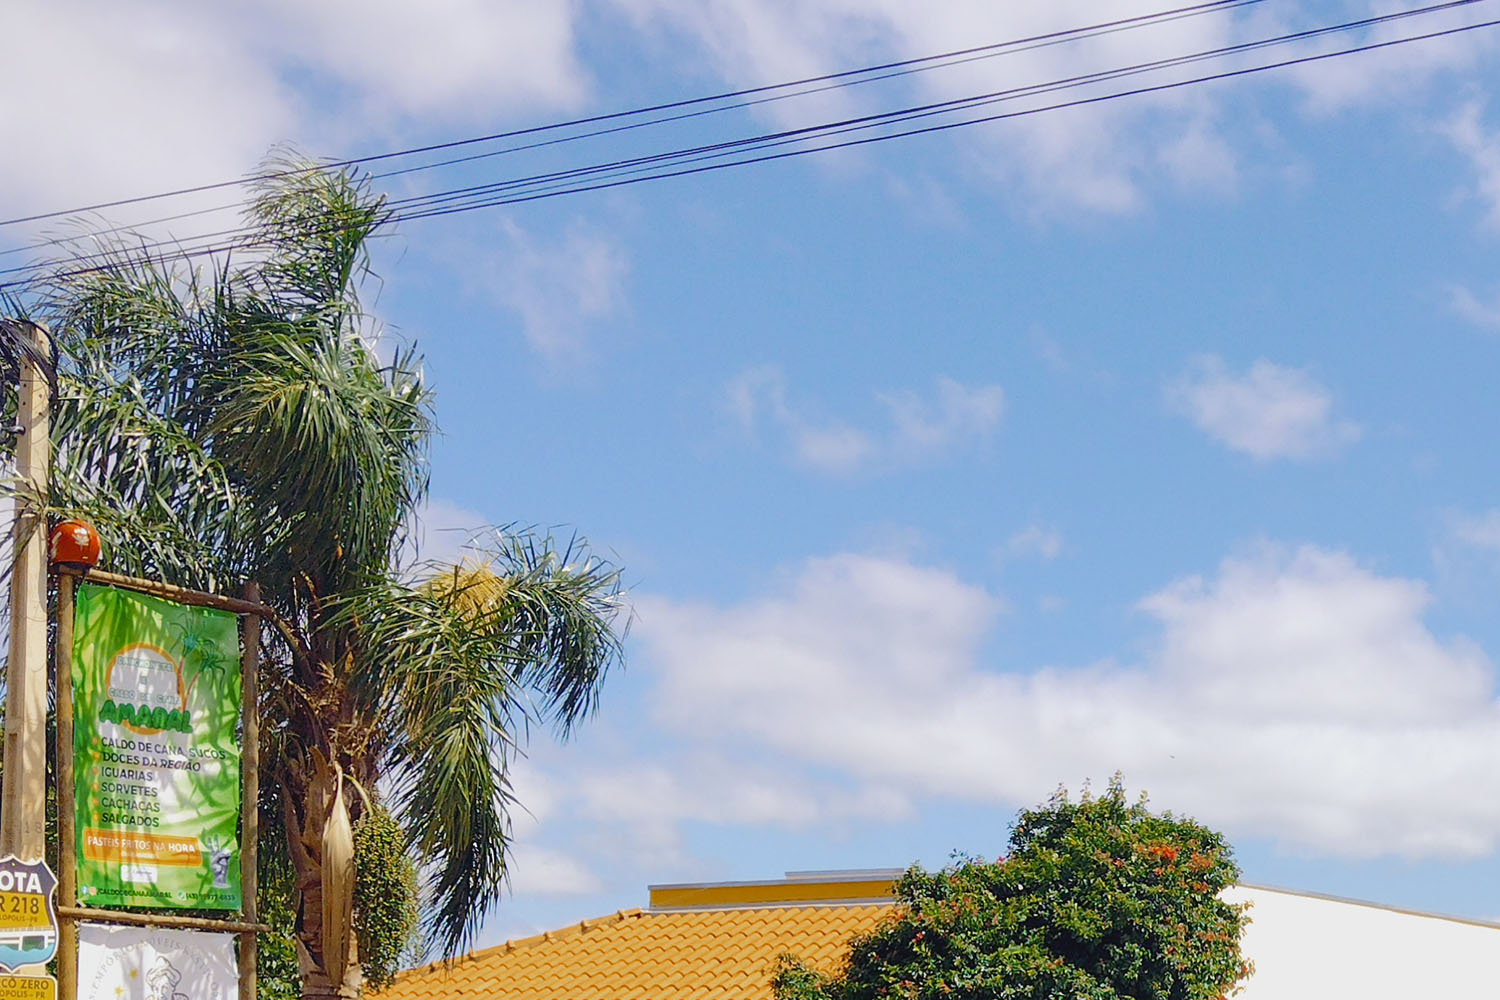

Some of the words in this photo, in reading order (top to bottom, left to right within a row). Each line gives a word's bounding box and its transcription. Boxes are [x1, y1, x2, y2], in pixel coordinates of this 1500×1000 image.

[99, 700, 193, 733] AMARAL
[101, 737, 136, 750] CALDO
[138, 742, 152, 753] DE
[189, 747, 226, 760] SUCOS
[103, 752, 140, 765] DOCES
[142, 757, 157, 768] DA
[101, 767, 153, 781] IGUARIAS
[101, 782, 158, 797] SORVETES
[101, 798, 160, 814] CACHAÇAS
[102, 812, 160, 827] SALGADOS
[168, 843, 195, 853] HORA
[11, 896, 39, 914] 218
[20, 979, 50, 990] ZERO
